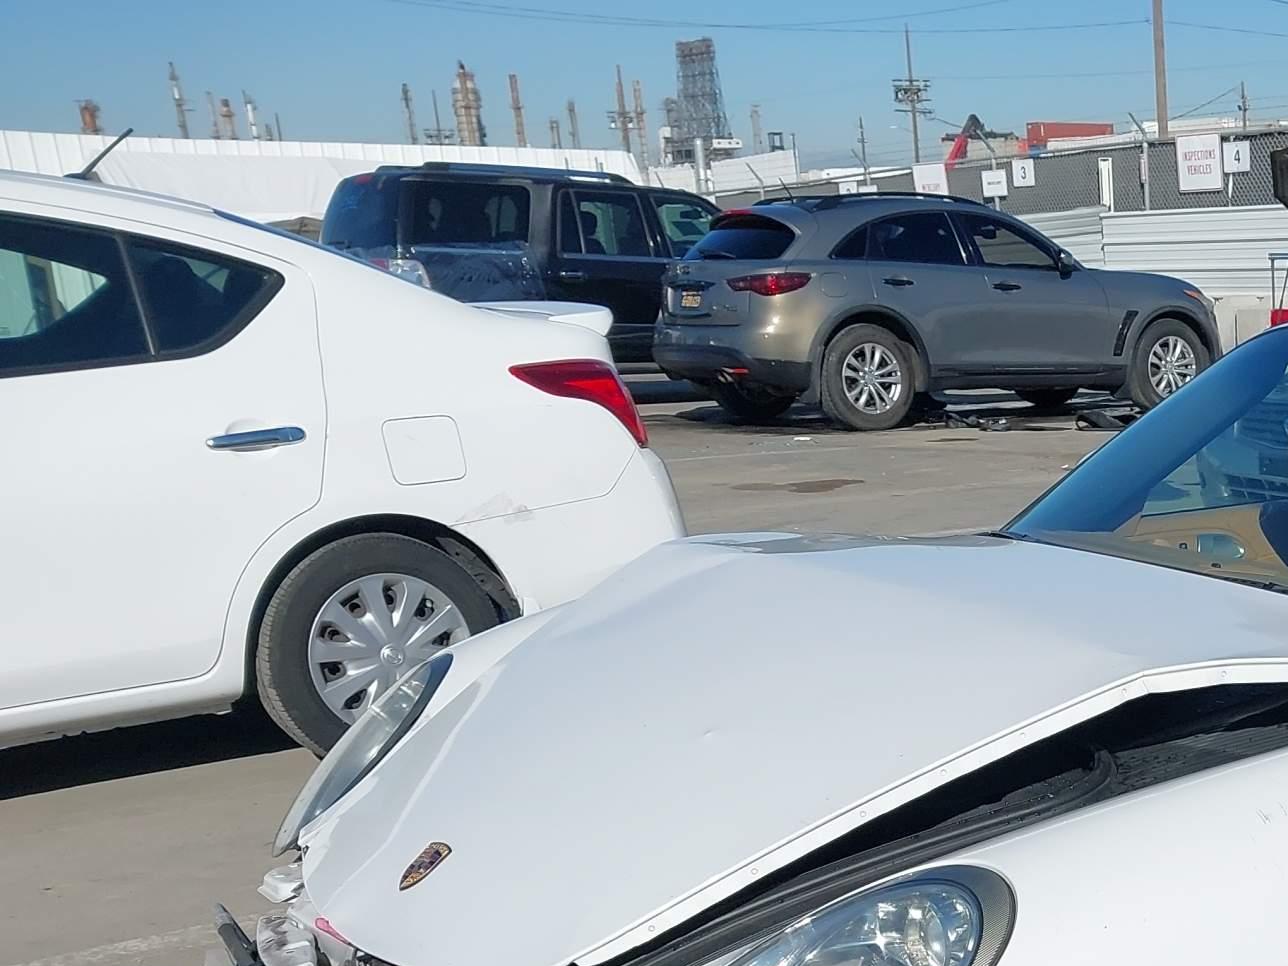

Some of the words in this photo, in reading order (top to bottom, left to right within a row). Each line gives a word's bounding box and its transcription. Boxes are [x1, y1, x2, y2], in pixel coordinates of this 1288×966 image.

[1183, 149, 1216, 161] INSPECTIONS
[1233, 149, 1241, 164] 4
[1020, 166, 1027, 180] 3
[1187, 164, 1212, 175] VEHICLES
